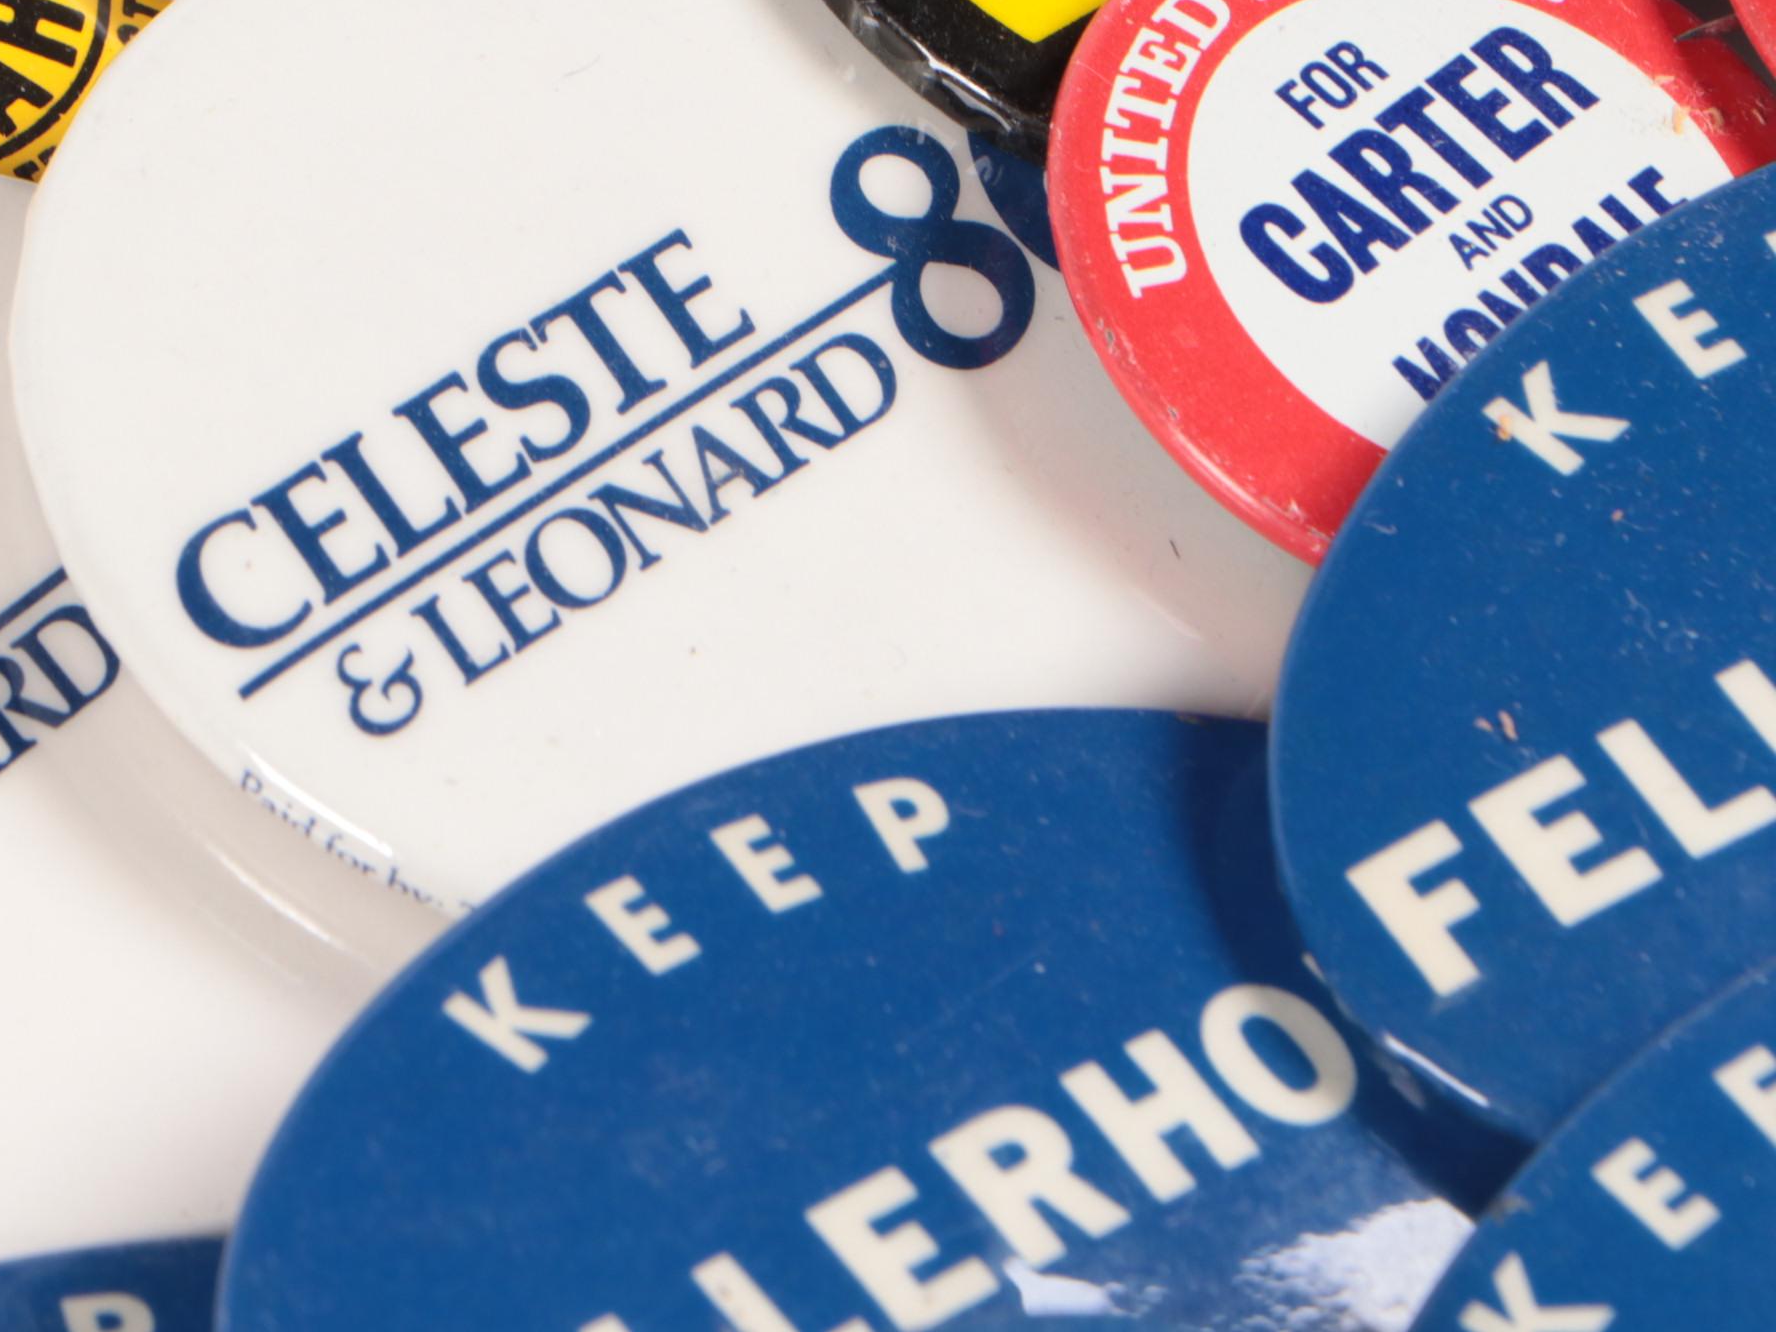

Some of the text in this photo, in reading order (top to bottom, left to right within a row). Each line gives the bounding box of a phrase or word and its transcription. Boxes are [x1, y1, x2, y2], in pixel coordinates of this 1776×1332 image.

[1238, 24, 1601, 304] CARTER
[1275, 40, 1391, 130] FOR
[1448, 193, 1534, 271] AND
[174, 227, 757, 650] CELESTE
[335, 331, 898, 737] & LEONARD
